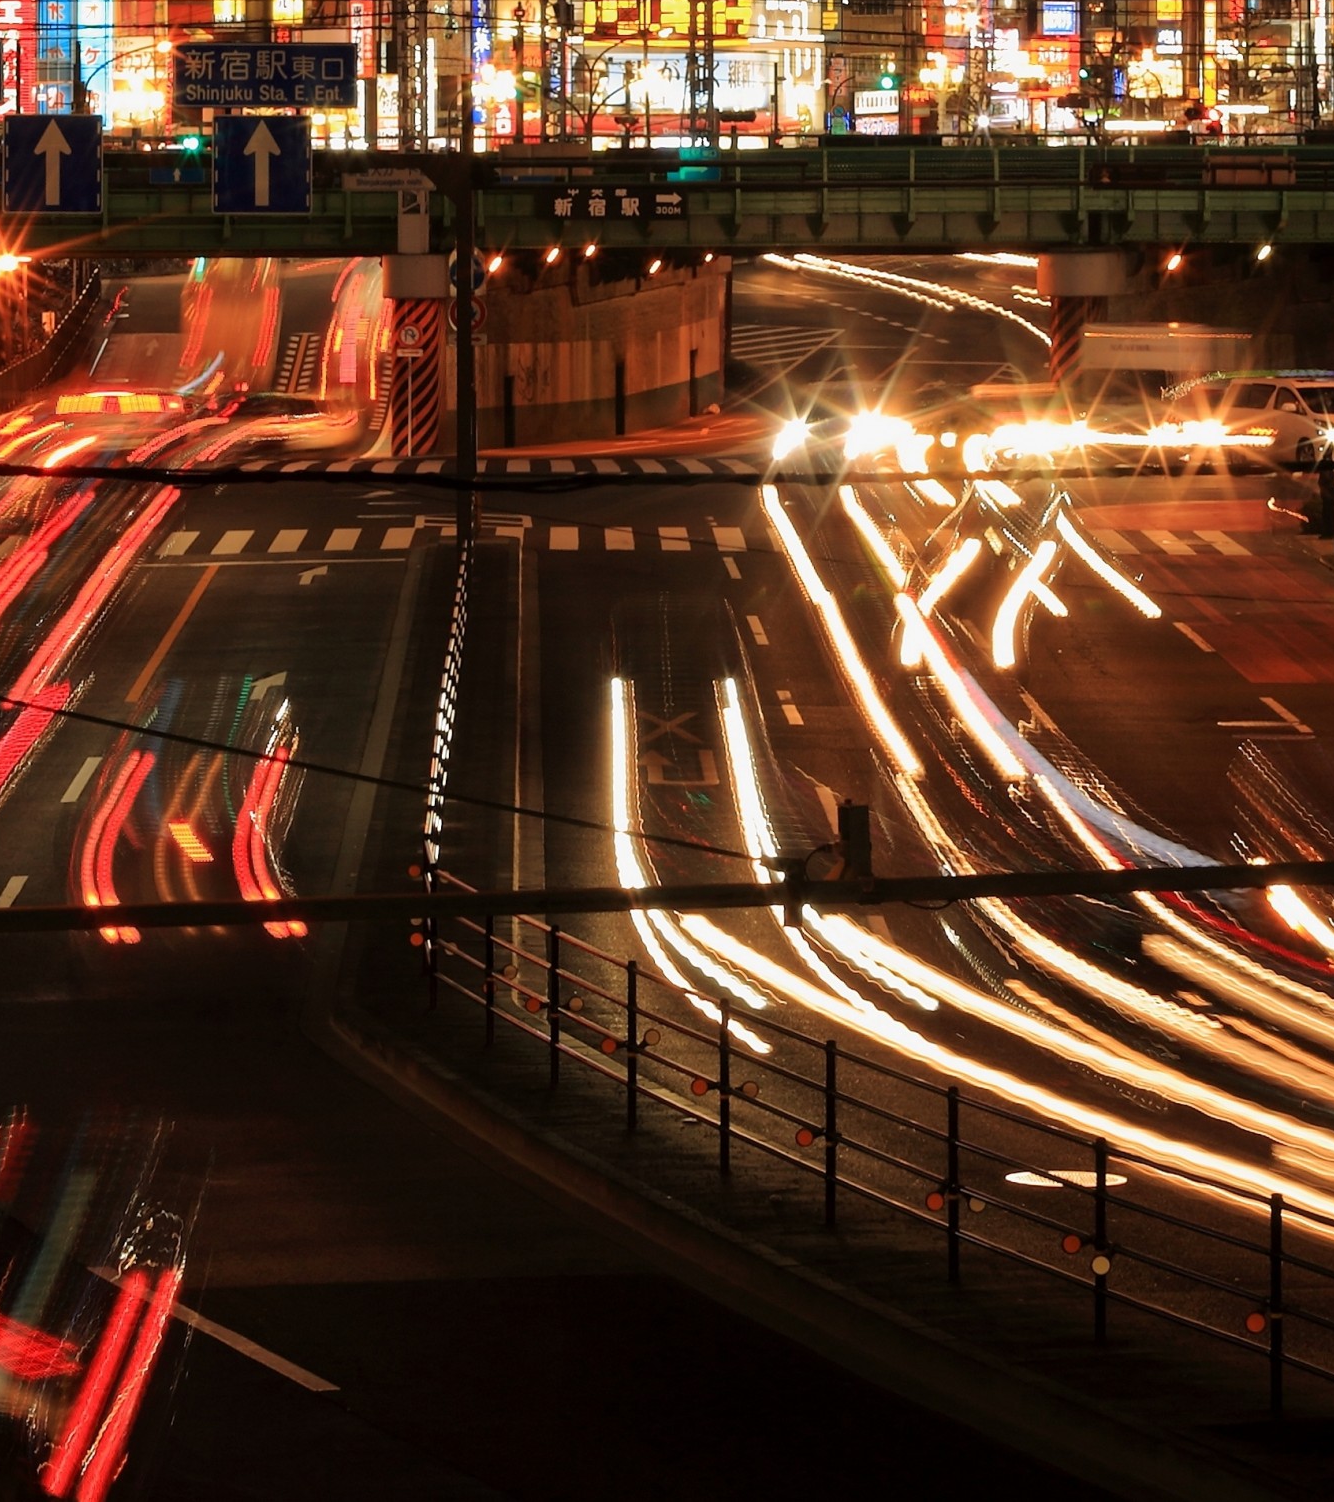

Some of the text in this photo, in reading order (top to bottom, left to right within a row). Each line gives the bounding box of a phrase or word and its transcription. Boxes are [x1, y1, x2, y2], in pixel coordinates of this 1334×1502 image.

[183, 49, 345, 82] 新宿駅東口
[186, 84, 344, 104] Shinjuku Sta. E. Ent.
[553, 197, 641, 217] 新宿駅
